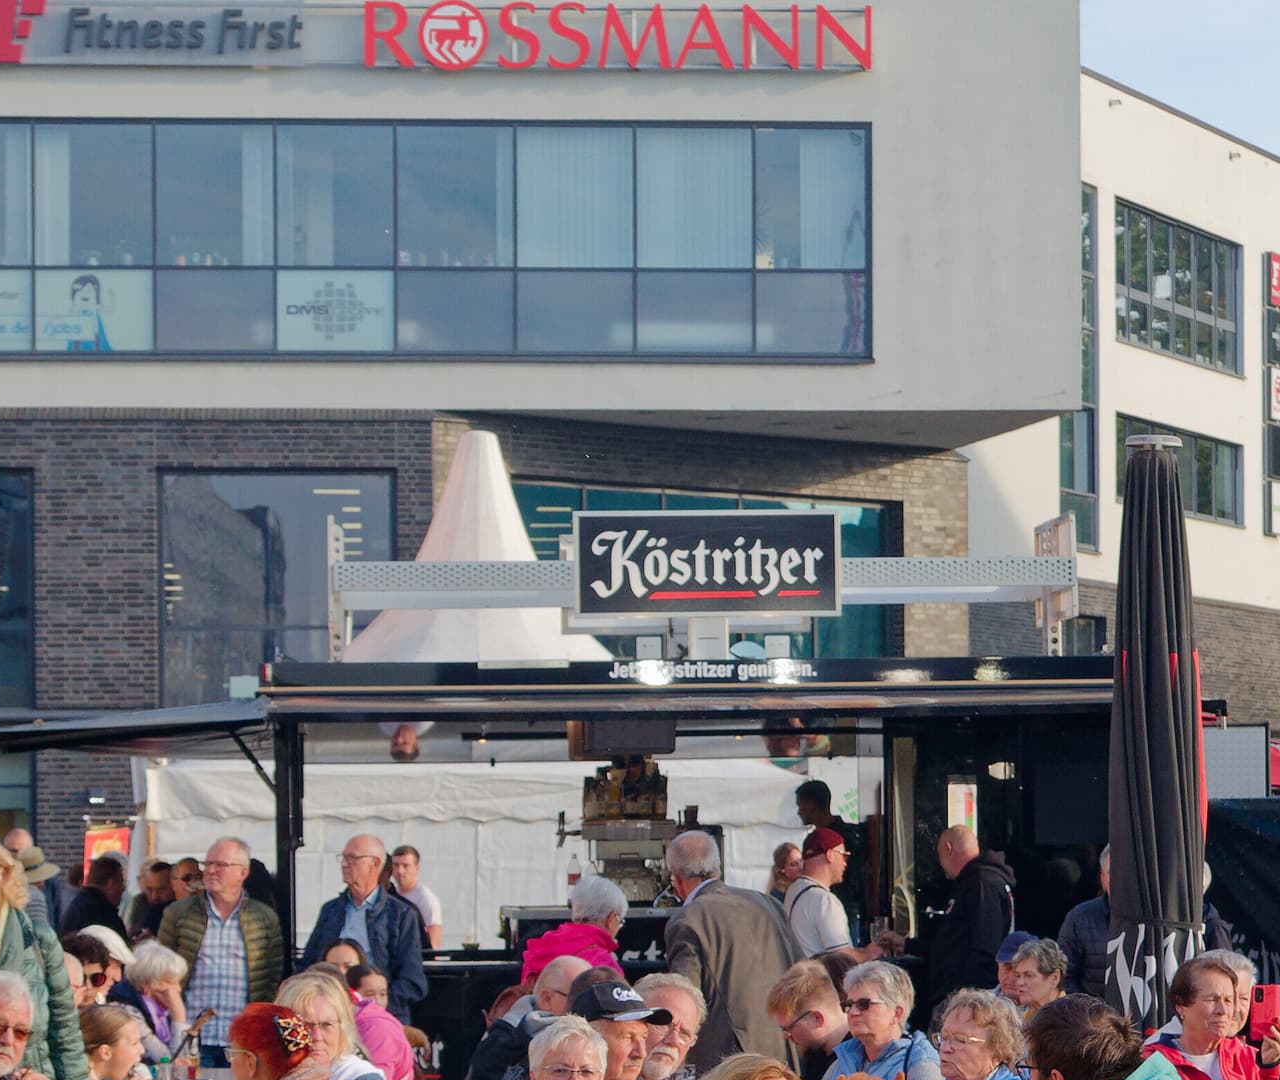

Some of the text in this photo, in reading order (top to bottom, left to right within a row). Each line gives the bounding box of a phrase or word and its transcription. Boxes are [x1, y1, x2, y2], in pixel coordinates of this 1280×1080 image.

[64, 7, 303, 55] Fitness First
[363, 1, 872, 71] ROSSMANN
[591, 530, 825, 599] Köstritzer
[657, 660, 734, 679] östritzer
